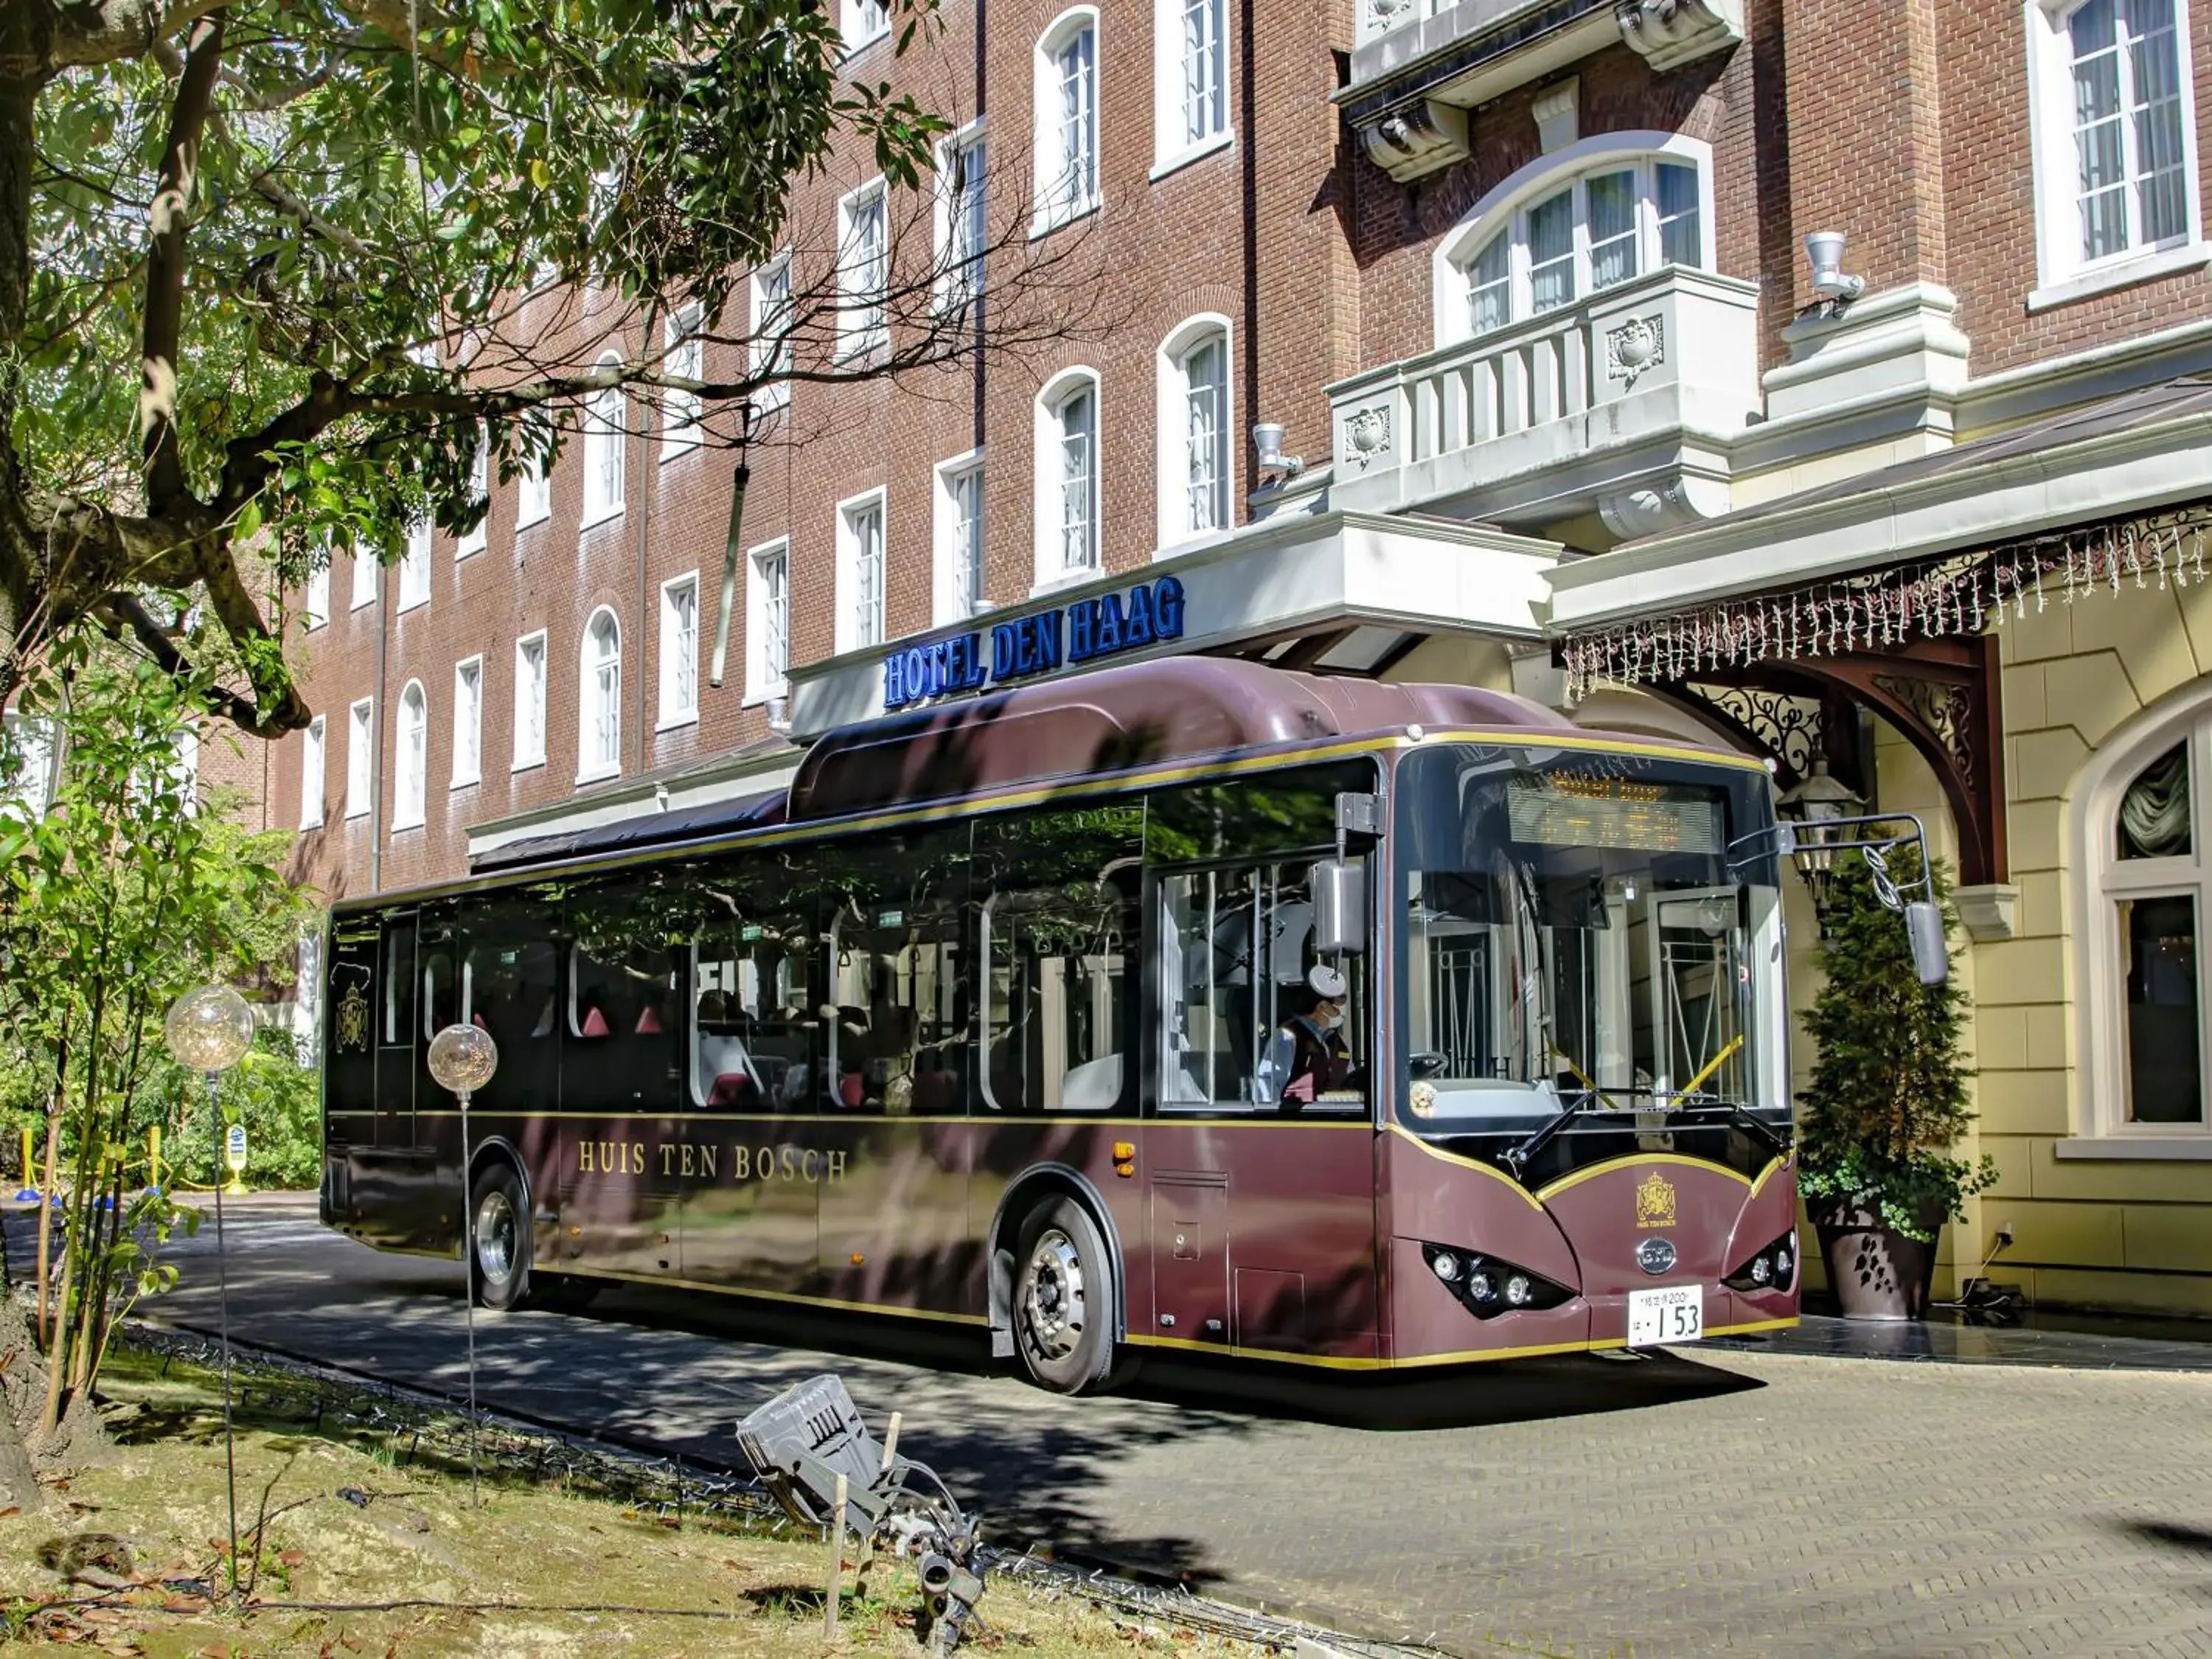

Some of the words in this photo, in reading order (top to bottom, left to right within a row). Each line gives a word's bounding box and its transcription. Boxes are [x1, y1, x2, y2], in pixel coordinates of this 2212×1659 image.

[883, 633, 987, 708] HOTEL
[990, 609, 1064, 682] DEN
[1068, 574, 1185, 663] HAAG
[578, 1141, 646, 1175] HUIS
[658, 1143, 718, 1178] TEN
[734, 1145, 848, 1185] BOSCH
